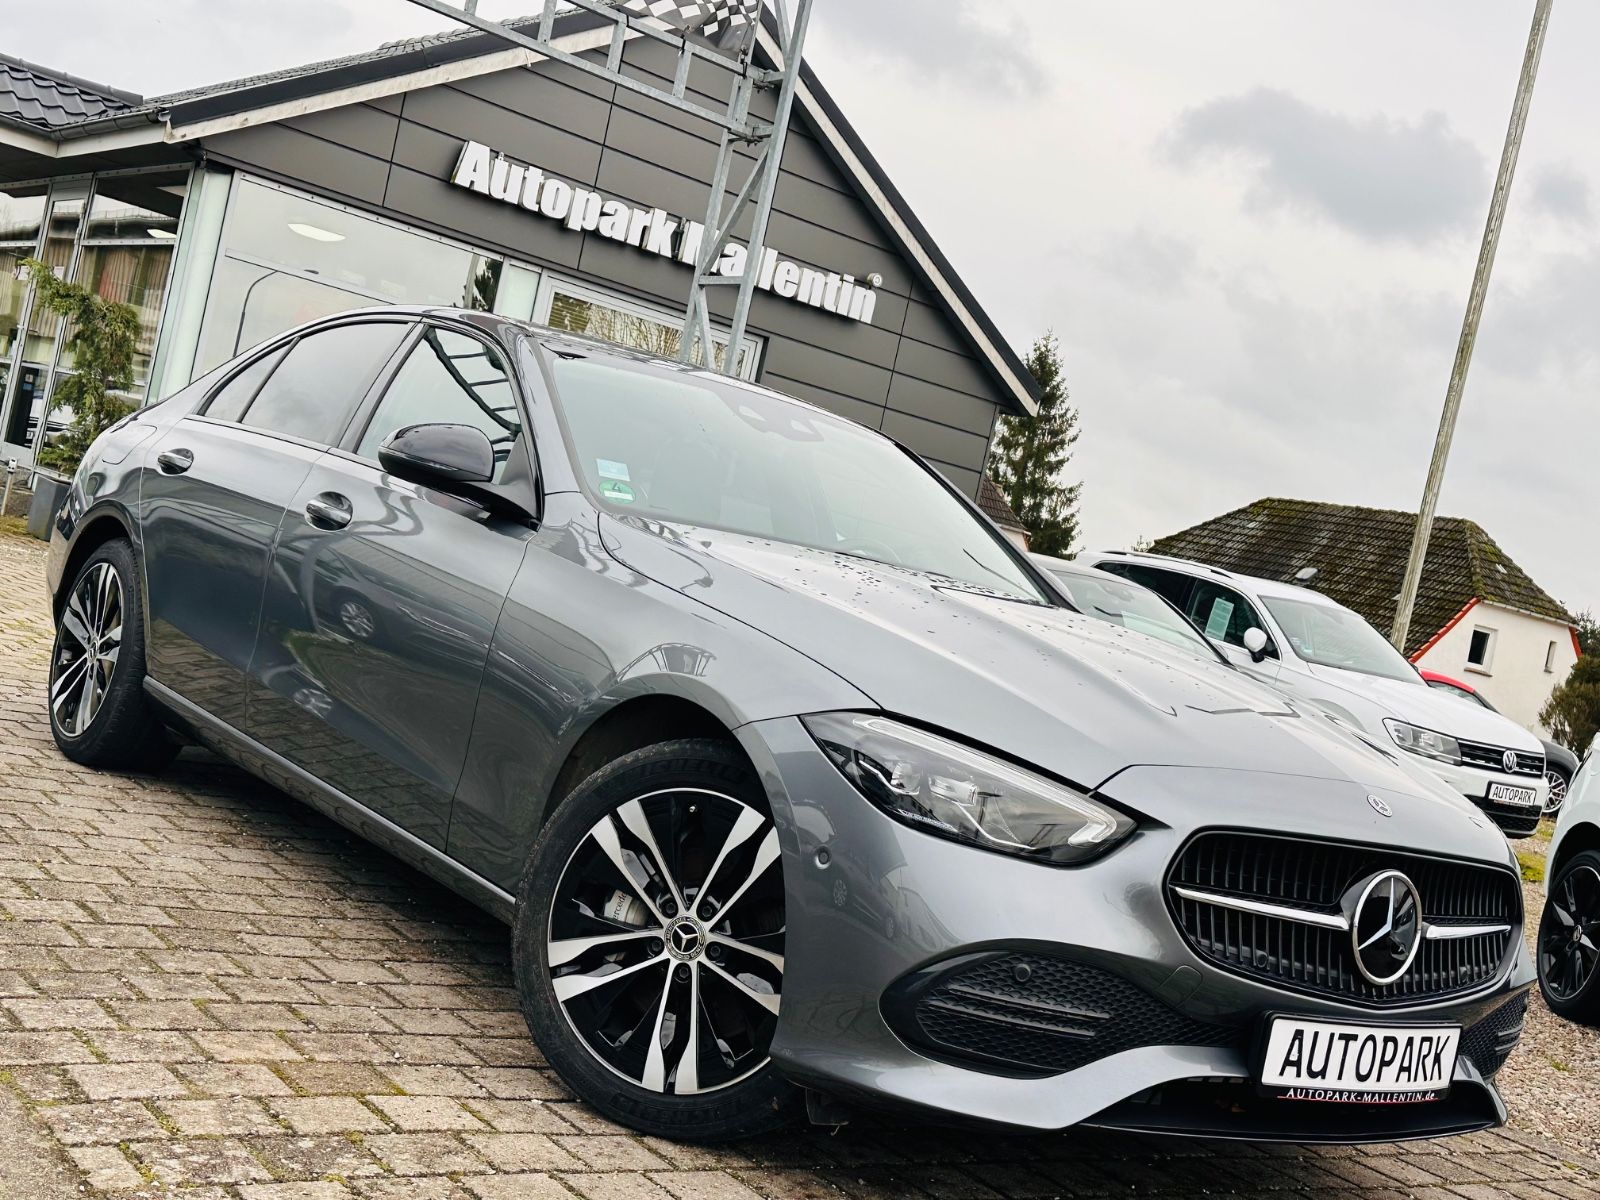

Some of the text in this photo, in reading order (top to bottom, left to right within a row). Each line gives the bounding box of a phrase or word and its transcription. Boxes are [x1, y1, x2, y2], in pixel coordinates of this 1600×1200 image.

[452, 140, 877, 324] Autopark Malentin
[1492, 786, 1533, 803] AUTOPARK
[1278, 1029, 1451, 1083] AUTOPARK
[1286, 1088, 1435, 1103] AUTOPARK-MALLENTIN.de
